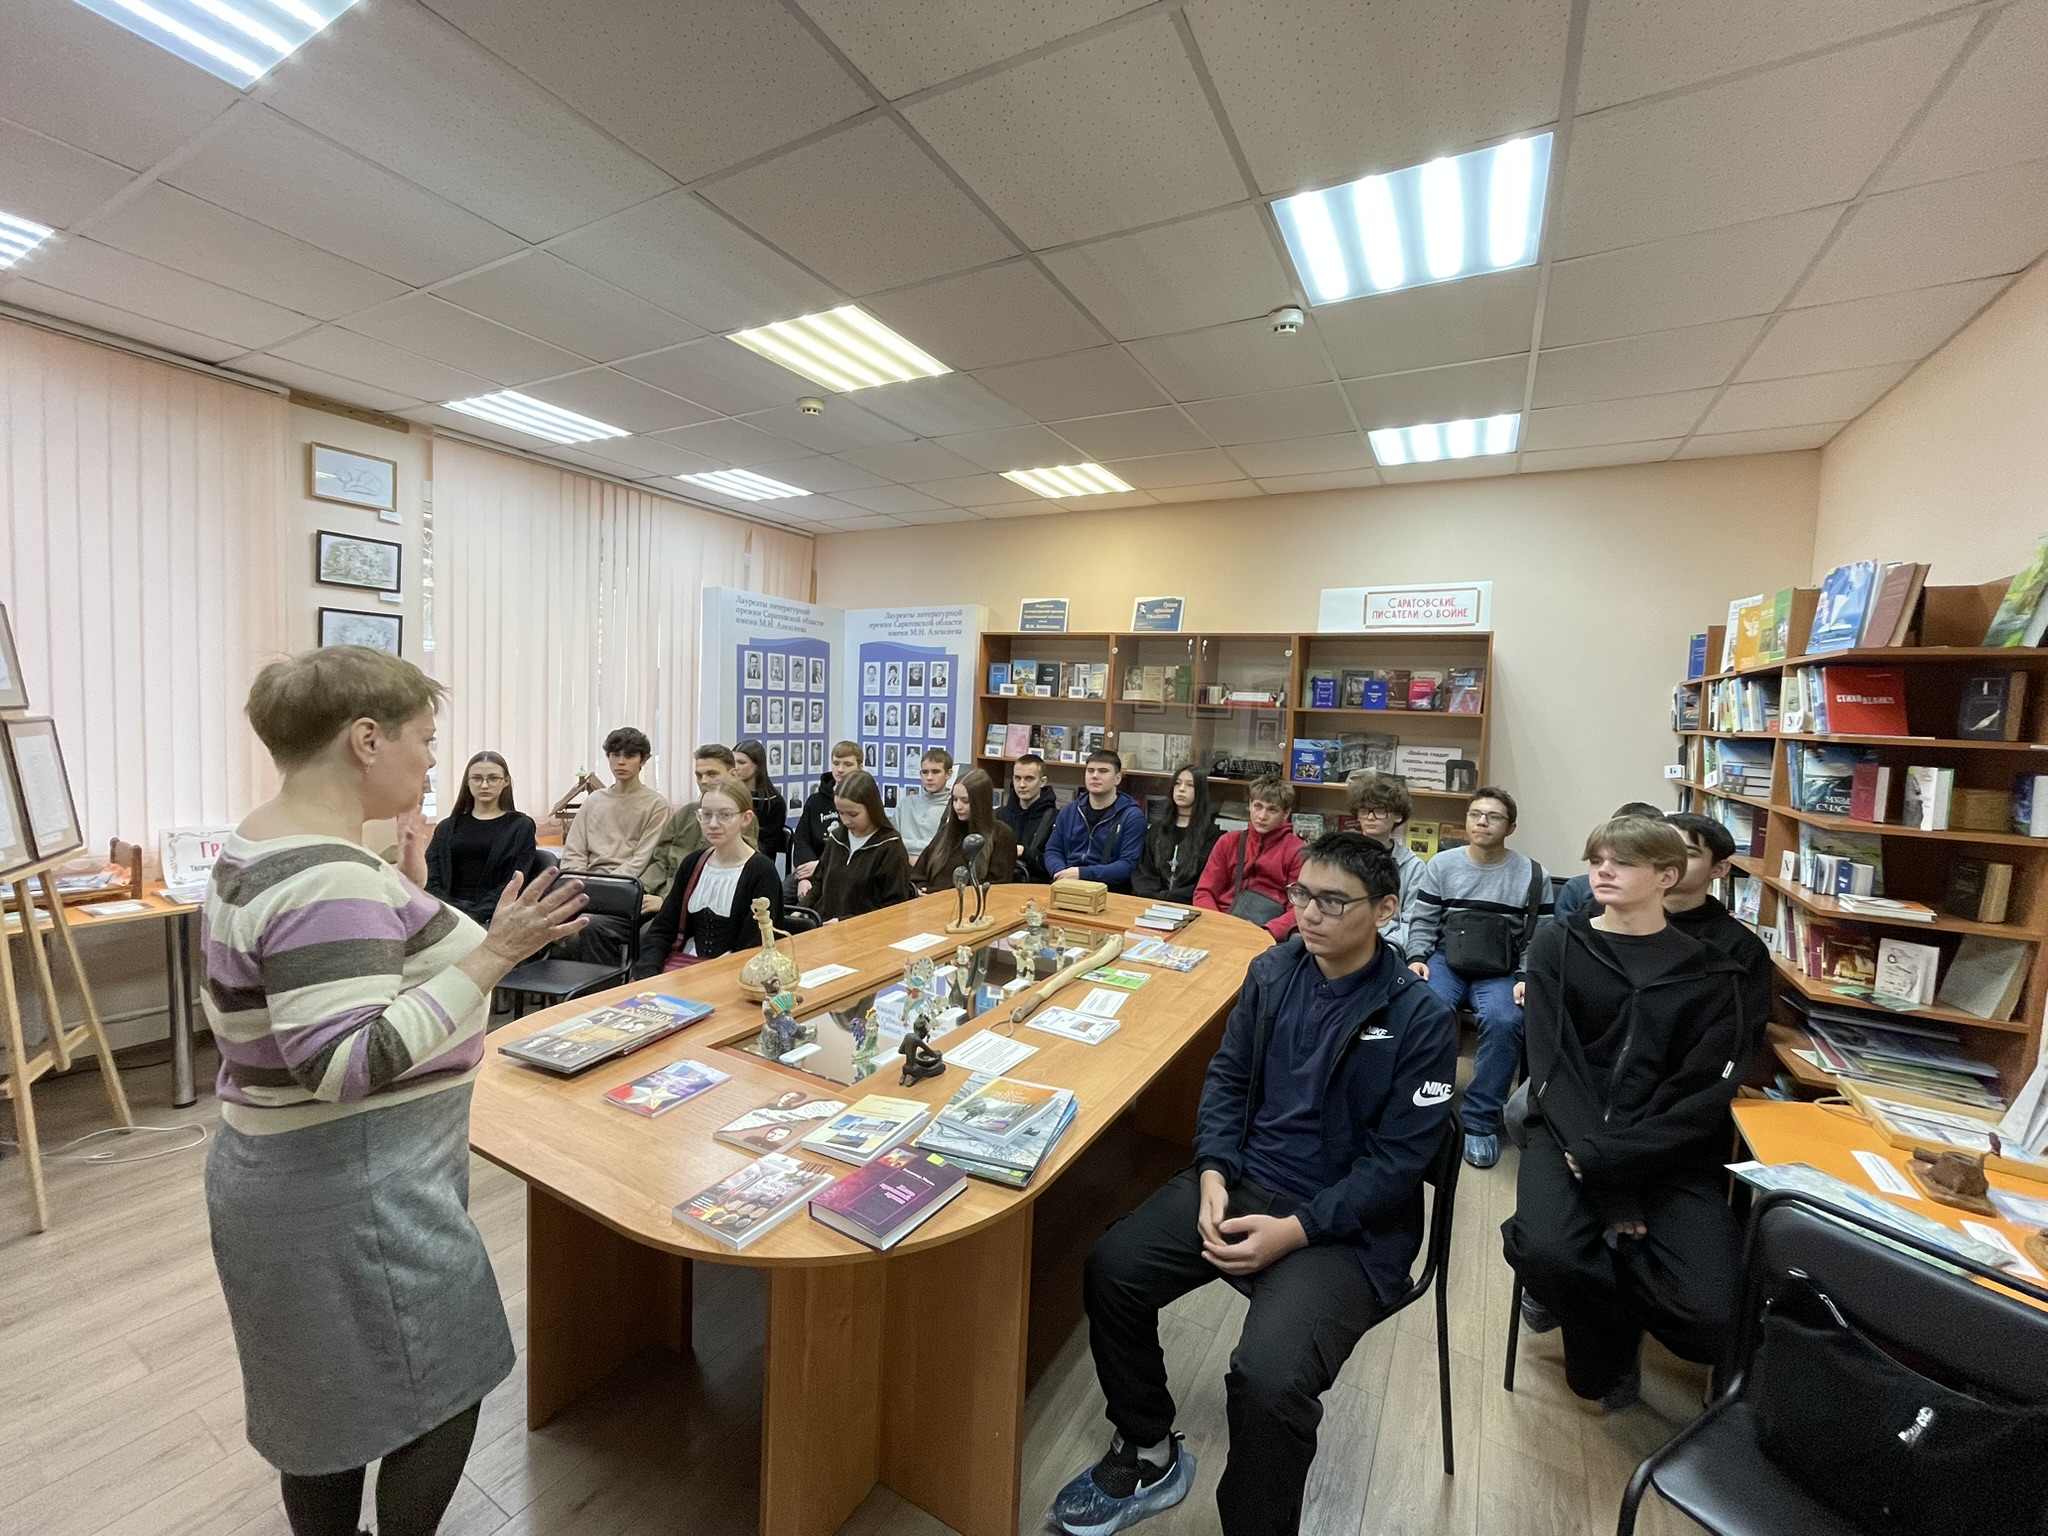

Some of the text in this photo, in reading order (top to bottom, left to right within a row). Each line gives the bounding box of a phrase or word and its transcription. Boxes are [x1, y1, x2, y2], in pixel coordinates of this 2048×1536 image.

[736, 595, 810, 615] Лауреаты литературной
[763, 610, 801, 622] Саратовской
[802, 616, 824, 626] области
[884, 609, 962, 620] Лауреаты литературной
[1372, 610, 1419, 619] ПИСАТЕЛИ
[1423, 609, 1432, 618] О
[777, 622, 806, 632] Алексеева
[894, 620, 934, 629] Саратовской
[200, 841, 225, 858] ГР
[1367, 1025, 1388, 1036] NIKE
[1421, 1081, 1452, 1096] NIKE
